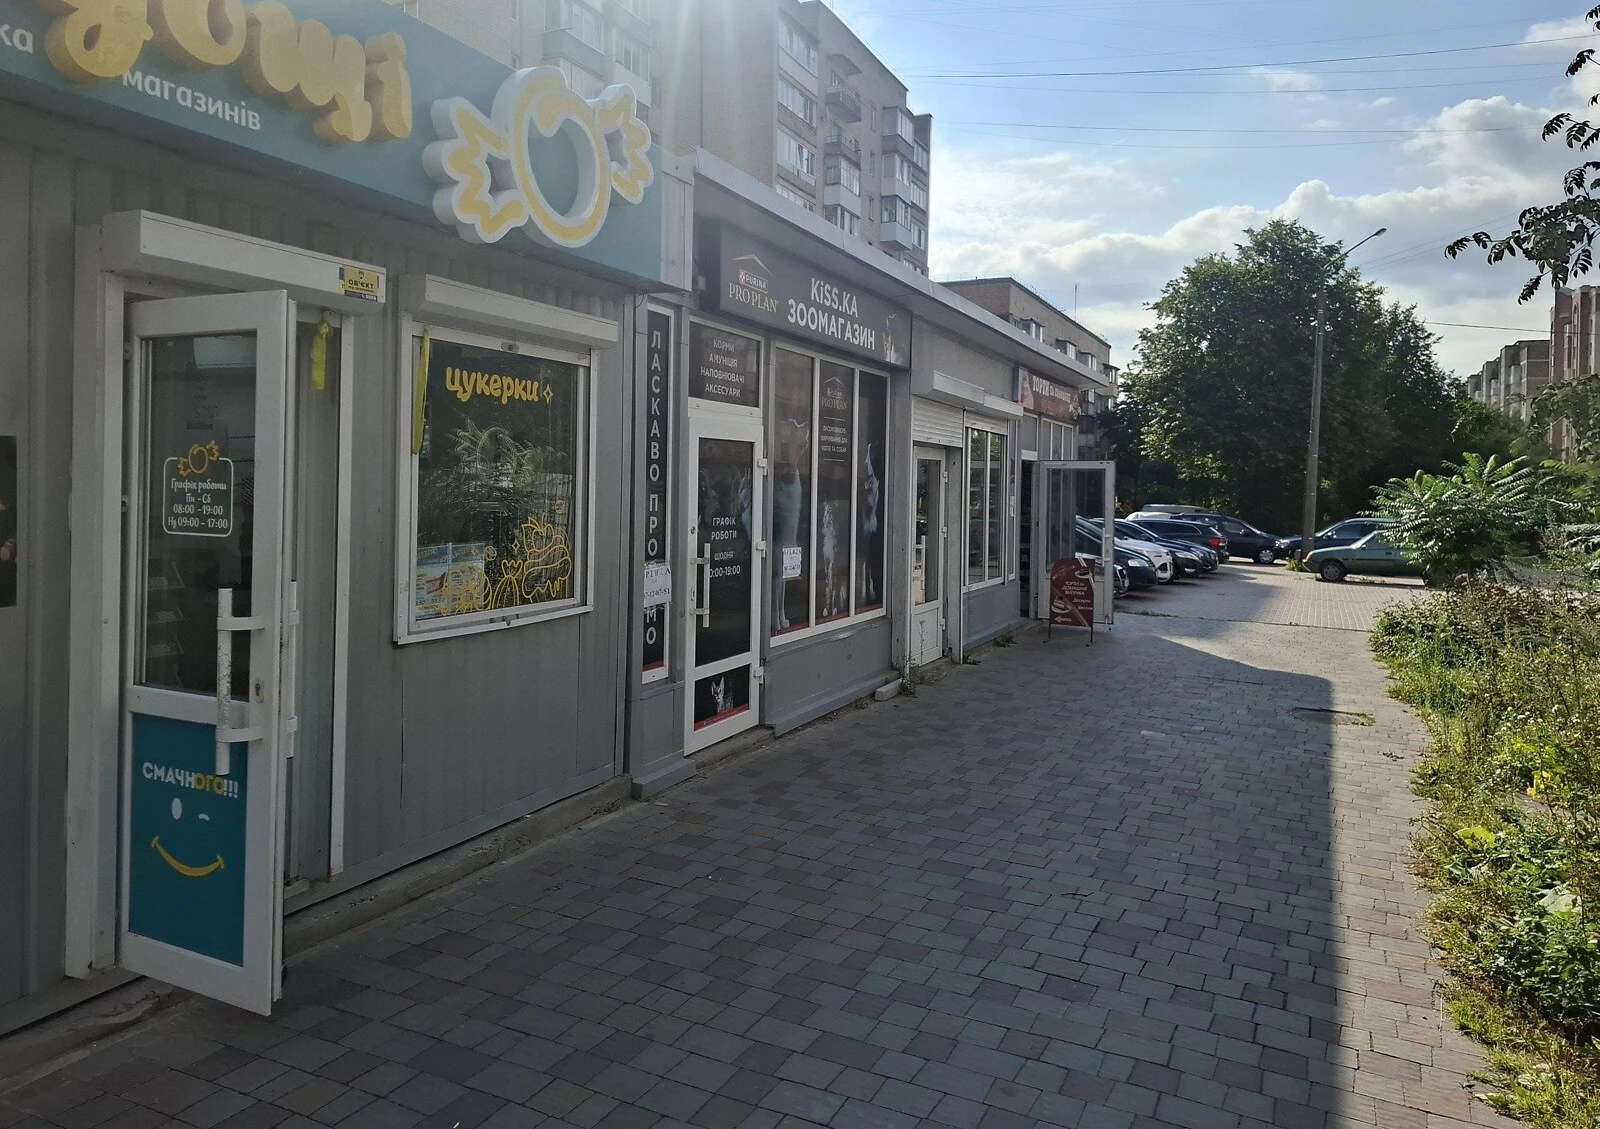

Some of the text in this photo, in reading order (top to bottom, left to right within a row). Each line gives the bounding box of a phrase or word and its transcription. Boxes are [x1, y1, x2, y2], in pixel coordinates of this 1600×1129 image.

[122, 67, 262, 132] магазинів
[745, 274, 767, 290] PURINA
[787, 298, 875, 350] ЗООМАГАЗИН
[713, 339, 735, 353] КОРМИ
[705, 383, 741, 397] АКСЕСУАРИ
[650, 330, 662, 482] ЛАСКАВО
[173, 504, 195, 514] 08:00
[177, 516, 200, 527] 09:00
[206, 518, 228, 529] 17:00
[712, 517, 736, 527] ГРАФІК
[711, 530, 737, 541] РОБОТИ
[646, 494, 659, 644] ПРОМО
[142, 761, 239, 799] СМАЧНОГО!!!
